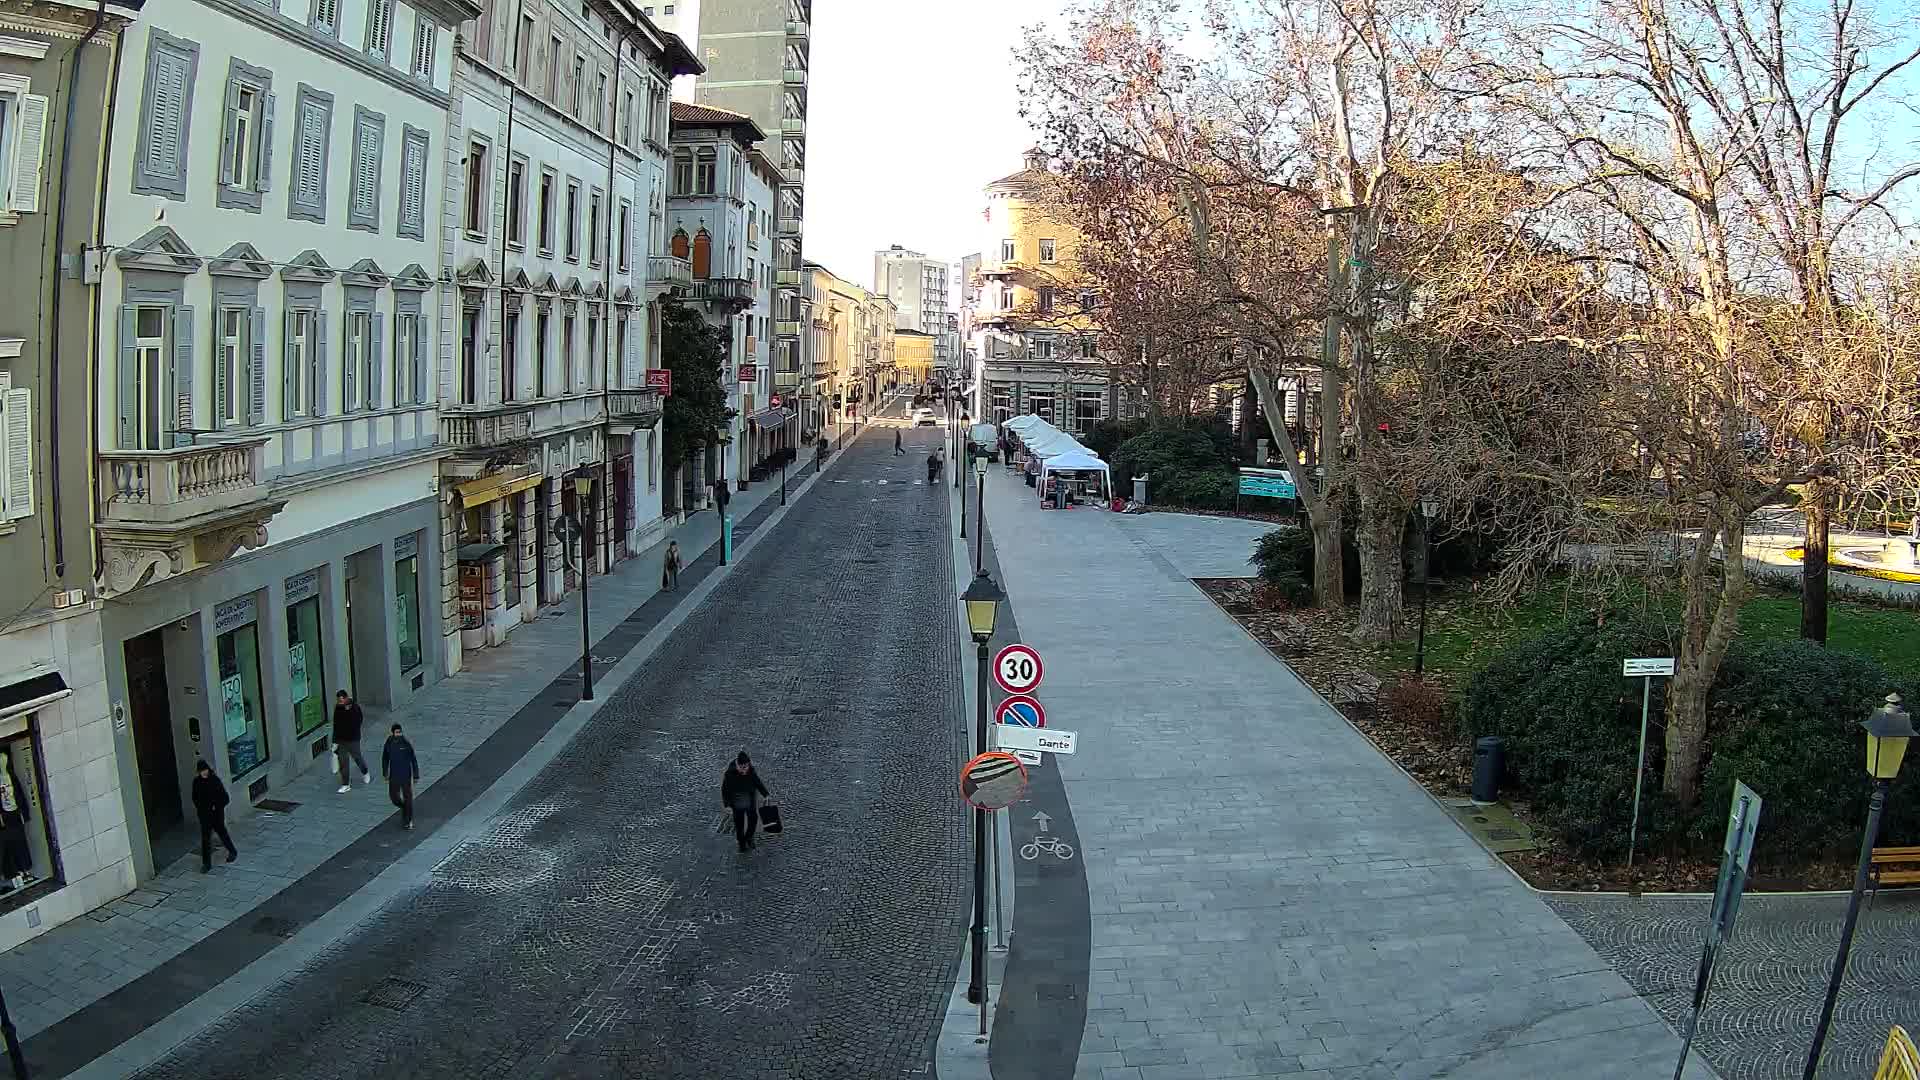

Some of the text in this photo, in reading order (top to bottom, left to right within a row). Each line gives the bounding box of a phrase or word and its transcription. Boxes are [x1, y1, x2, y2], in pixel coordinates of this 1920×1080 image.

[1005, 658, 1033, 680] 30
[223, 678, 241, 700] 130
[1038, 738, 1070, 749] Dante
